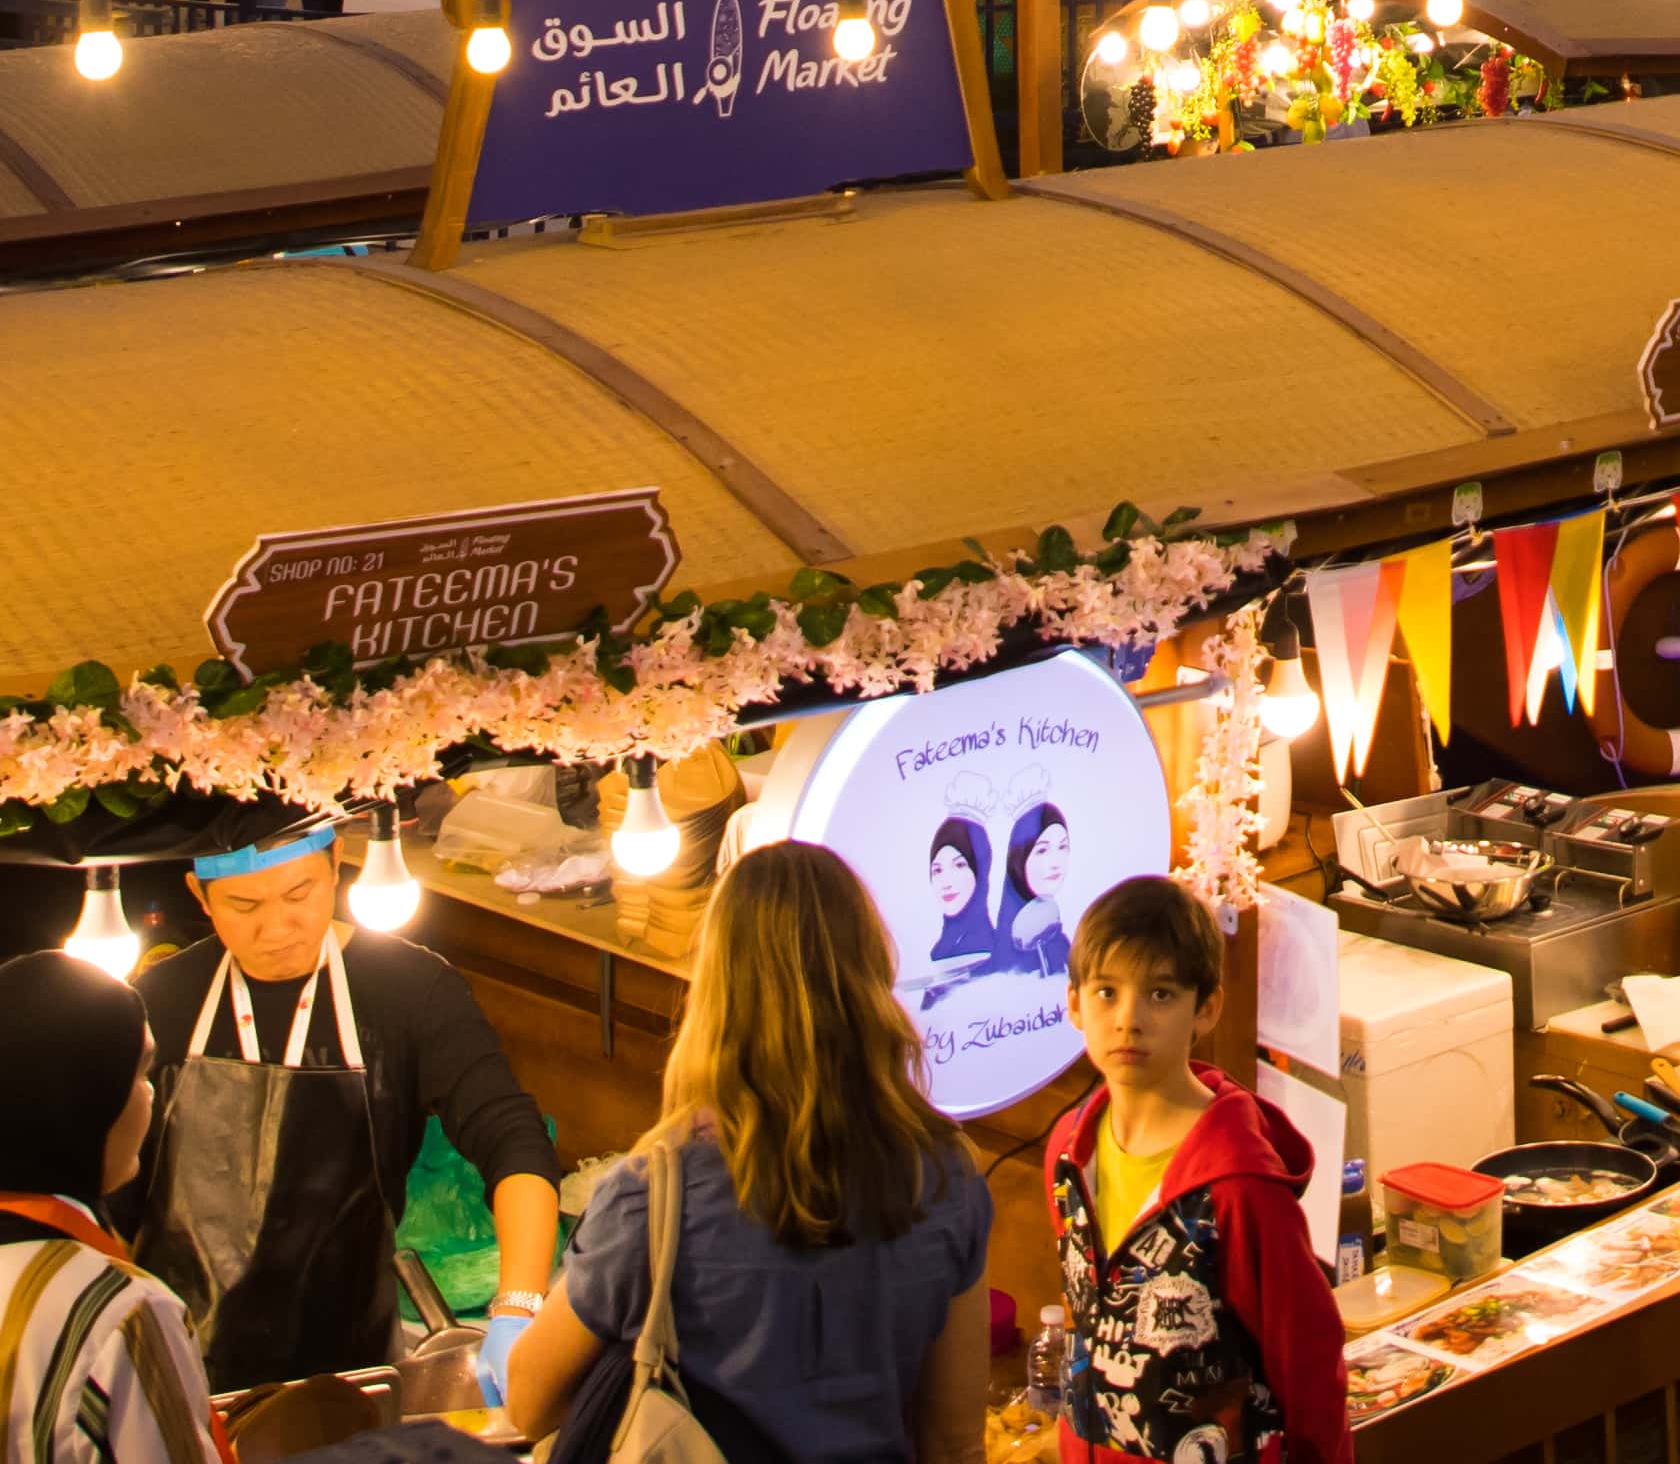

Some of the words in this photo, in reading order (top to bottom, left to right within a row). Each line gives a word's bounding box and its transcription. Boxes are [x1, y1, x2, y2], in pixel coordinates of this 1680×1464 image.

[531, 1, 687, 62] السوق
[544, 61, 686, 118] العائم
[755, 43, 898, 96] Market
[269, 558, 322, 583] SHOP
[362, 552, 385, 572] 21
[323, 554, 579, 622] FATEEMA'S
[351, 600, 539, 658] KITCHEN
[895, 721, 1007, 781] Fateema's
[1017, 716, 1100, 753] Kitchen
[924, 1026, 955, 1065] by
